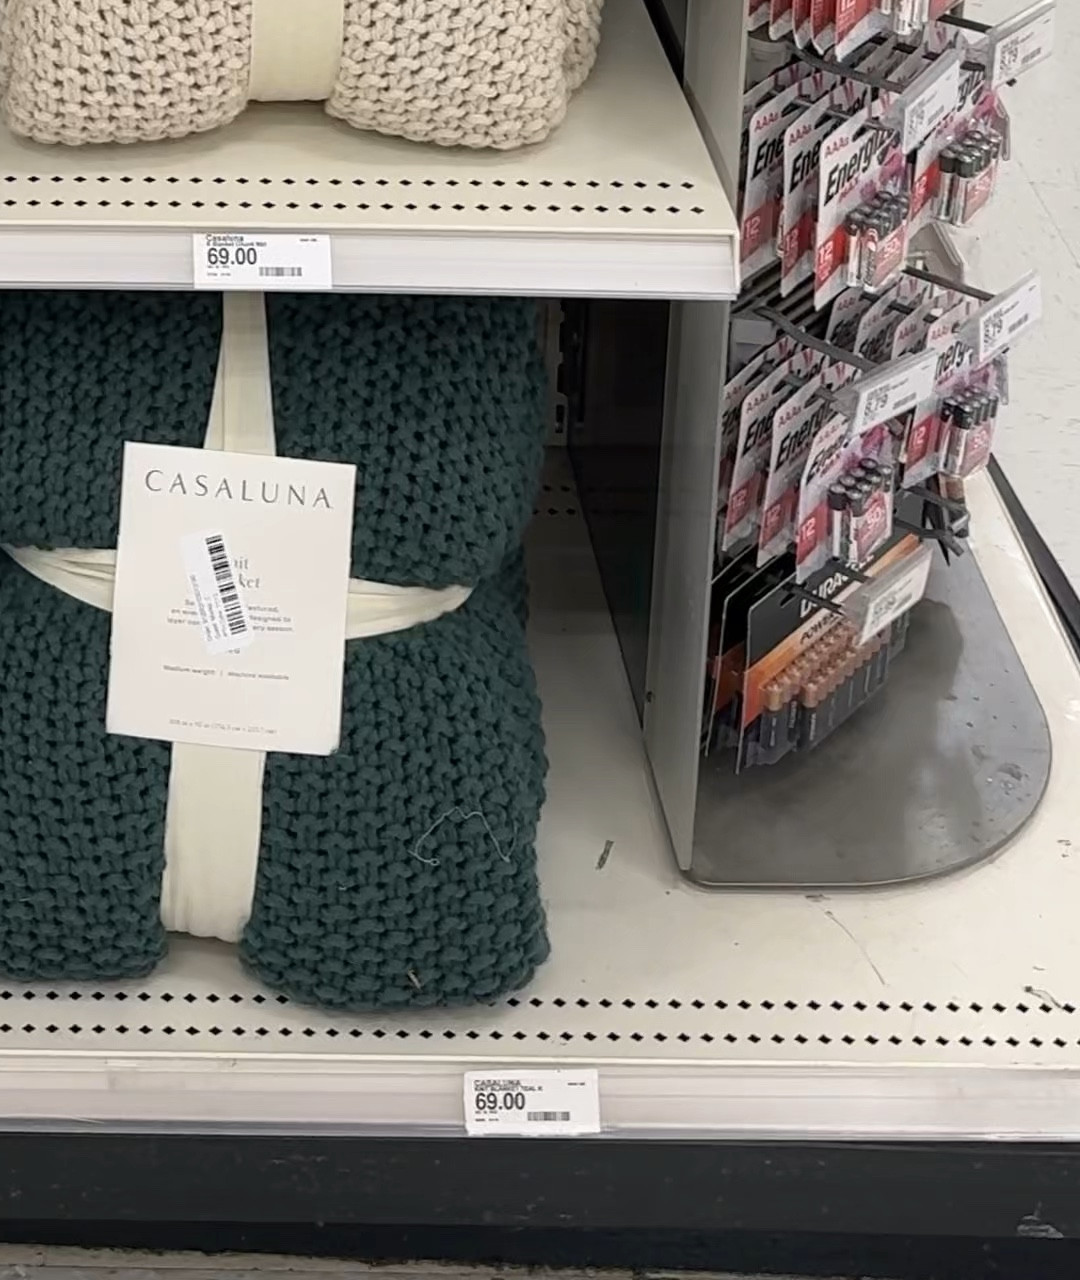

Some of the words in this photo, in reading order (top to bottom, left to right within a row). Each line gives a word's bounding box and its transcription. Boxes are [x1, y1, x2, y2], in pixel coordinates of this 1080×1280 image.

[207, 247, 257, 265] 69.00
[145, 469, 332, 509] CASALUNA
[475, 1093, 526, 1110] 69.00
